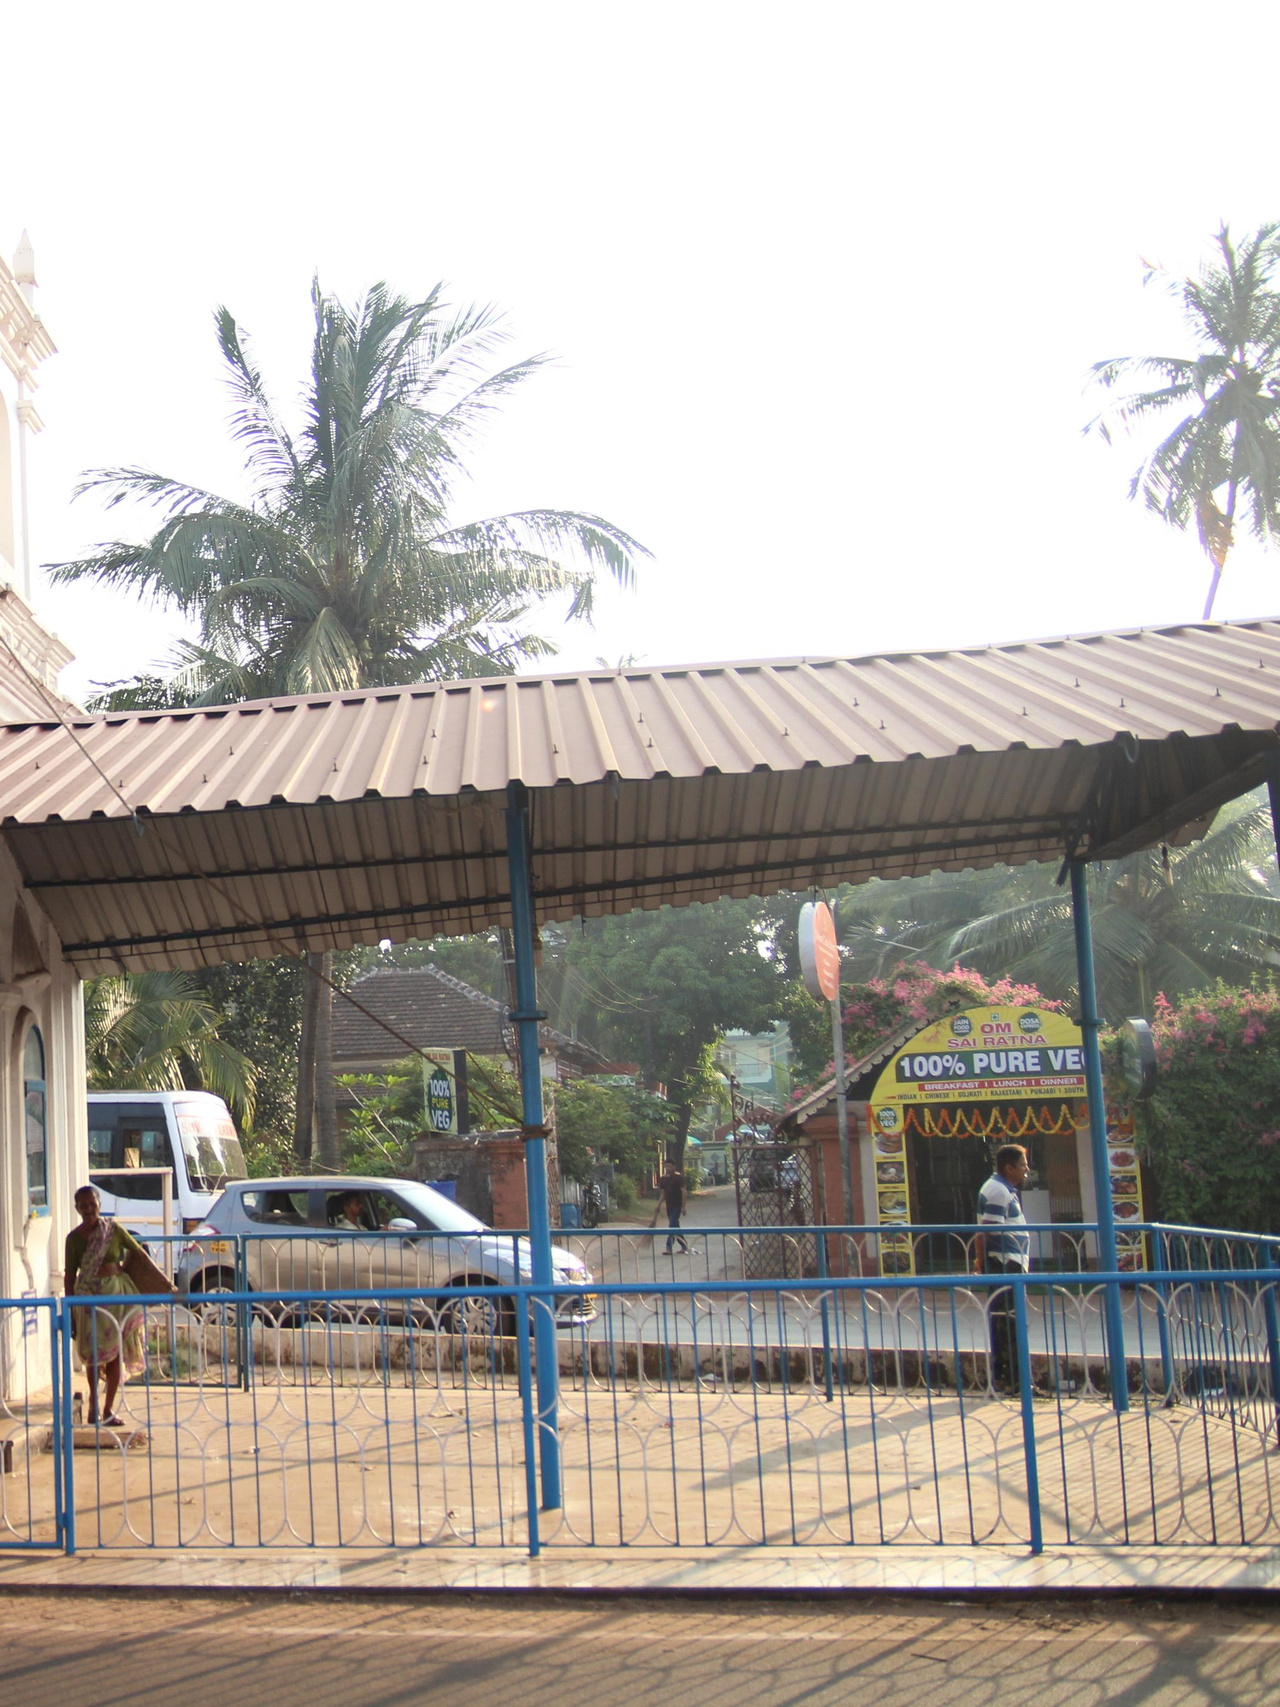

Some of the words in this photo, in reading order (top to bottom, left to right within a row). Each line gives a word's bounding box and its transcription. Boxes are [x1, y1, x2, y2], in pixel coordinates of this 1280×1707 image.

[980, 1023, 1012, 1034] OM
[947, 1038, 977, 1048] SAI
[983, 1035, 1047, 1046] RATNA
[901, 1054, 966, 1077] 100%
[973, 1050, 1041, 1074] PURE
[1047, 1049, 1085, 1071] VE
[430, 1079, 449, 1097] 100%
[924, 1082, 980, 1090] BREAKFAST
[431, 1097, 449, 1108] PURE
[431, 1109, 450, 1129] VEG
